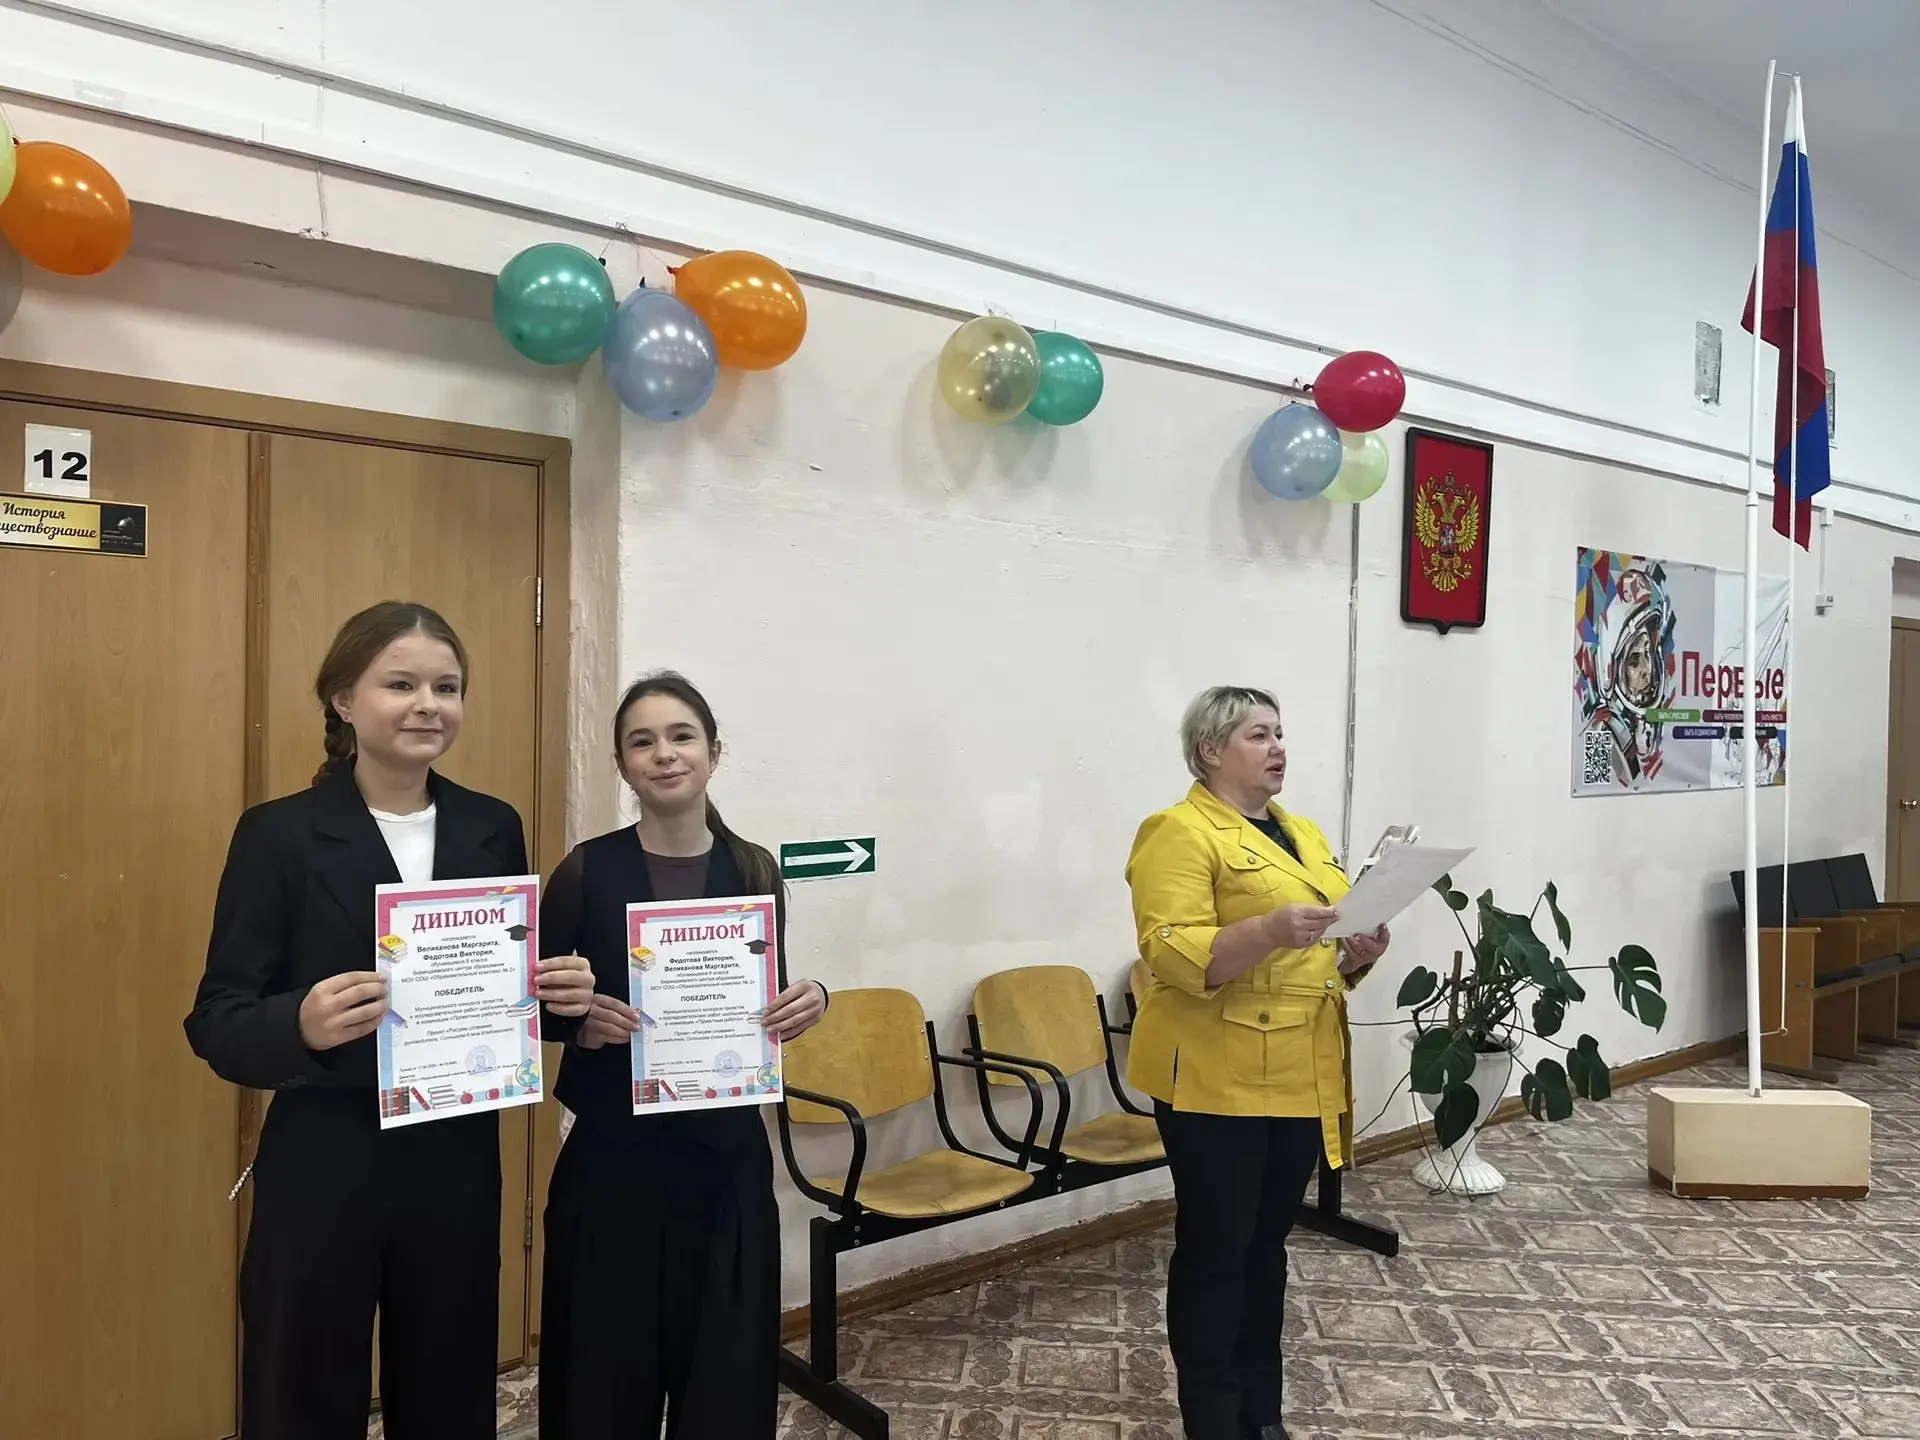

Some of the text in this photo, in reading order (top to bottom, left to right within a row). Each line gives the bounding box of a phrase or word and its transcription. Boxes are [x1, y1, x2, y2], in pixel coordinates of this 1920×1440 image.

[34, 449, 87, 481] 12
[3, 502, 66, 523] История
[412, 908, 505, 933] ДИПЛОМ
[659, 924, 745, 945] ДИПЛОМ
[417, 939, 500, 953] Великанова Маргарита,
[423, 949, 495, 961] Федотова Виктория,
[705, 962, 740, 970] Маргарита,
[435, 985, 484, 997] ПОБЕДИТЕЛЬ
[680, 993, 727, 1003] ПОБЕДИТЕЛЬ
